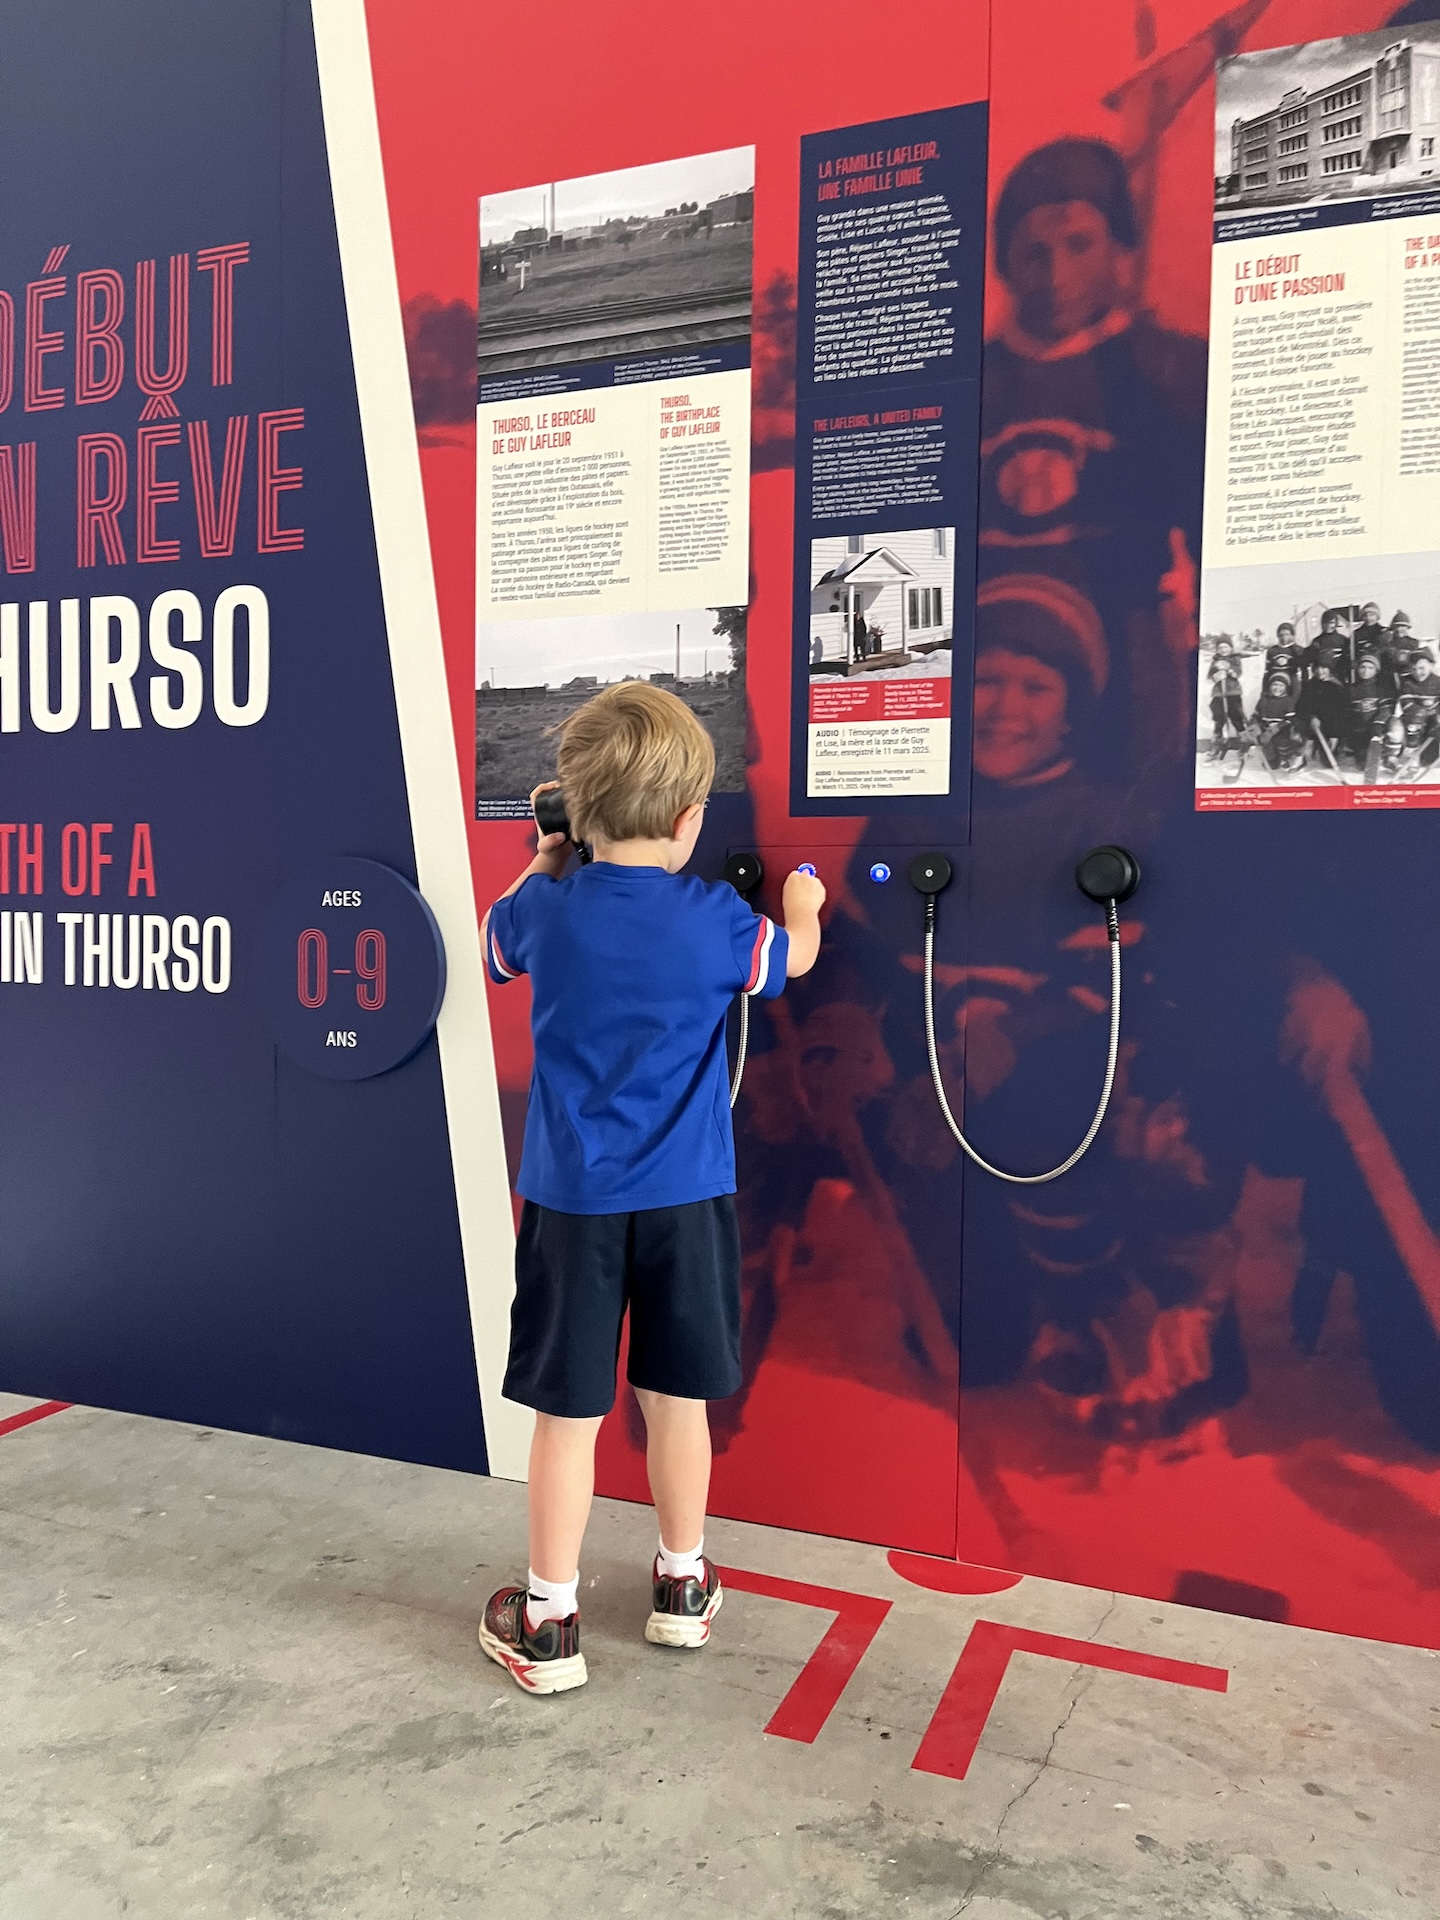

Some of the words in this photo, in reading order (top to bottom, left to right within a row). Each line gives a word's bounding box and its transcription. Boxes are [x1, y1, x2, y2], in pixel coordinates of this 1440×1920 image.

[818, 160, 832, 179] LA
[836, 151, 883, 176] FAMILLE
[887, 141, 940, 167] LAFLEUR,
[818, 181, 841, 202] UNE
[844, 172, 892, 197] FAMILLE
[896, 166, 924, 187] UNIE
[1405, 236, 1425, 252] THE
[1235, 261, 1251, 280] LE
[1256, 253, 1302, 278] DÉBUT
[1405, 255, 1419, 269] OF
[1421, 254, 1427, 267] A
[1431, 253, 1440, 266] P
[1235, 281, 1279, 305] D'UNE
[1282, 272, 1345, 298] PASSION
[0, 241, 250, 414] ÉBUT
[660, 395, 692, 408] THURSO,
[493, 416, 534, 434] THURSO,
[537, 414, 548, 429] LE
[552, 408, 595, 427] BERCEAU
[660, 412, 673, 424] THE
[676, 406, 720, 422] BIRTHPLACE
[814, 419, 828, 432] THE
[874, 413, 879, 425] A
[882, 409, 910, 424] UNITED
[913, 406, 943, 421] FAMILY
[660, 427, 669, 439] OF
[672, 425, 686, 437] GUY
[689, 422, 720, 435] LAFLEUR
[493, 439, 504, 454] DE
[508, 436, 526, 453] GUY
[530, 432, 571, 450] LAFLEUR
[492, 463, 502, 472] Guy
[503, 462, 523, 470] Lafleur
[525, 459, 535, 468] voit
[536, 459, 541, 467] le
[543, 458, 553, 468] jour
[555, 457, 560, 465] le
[562, 456, 570, 464] 20
[571, 453, 602, 464] septembre
[604, 451, 618, 460] 1951
[77, 395, 304, 569] RÊVE
[492, 472, 512, 480] Thurso,
[525, 468, 541, 479] petite
[542, 467, 553, 475] ville
[491, 531, 505, 539] Dans
[506, 530, 515, 538] les
[516, 528, 537, 537] années
[565, 525, 582, 534] ligues
[584, 523, 591, 531] de
[592, 521, 613, 530] hockey
[615, 519, 629, 528] sont
[848, 728, 888, 737] Témoignage
[890, 727, 898, 735] de
[900, 726, 930, 734] Pierrette
[816, 749, 839, 758] Lafleur,
[840, 747, 873, 757] enregistré
[874, 747, 881, 755] le
[883, 747, 891, 755] 11
[911, 746, 931, 754] 2025.
[823, 739, 838, 749] Lise,
[839, 739, 846, 747] la
[866, 738, 872, 746] et
[874, 738, 880, 746] la
[900, 737, 909, 745] de
[910, 737, 924, 746] Guy
[61, 822, 113, 896] OF
[128, 823, 157, 897] A
[321, 890, 362, 907] AGES
[0, 911, 43, 984] IN
[56, 912, 232, 994] THURSO
[325, 1031, 358, 1048] ANS
